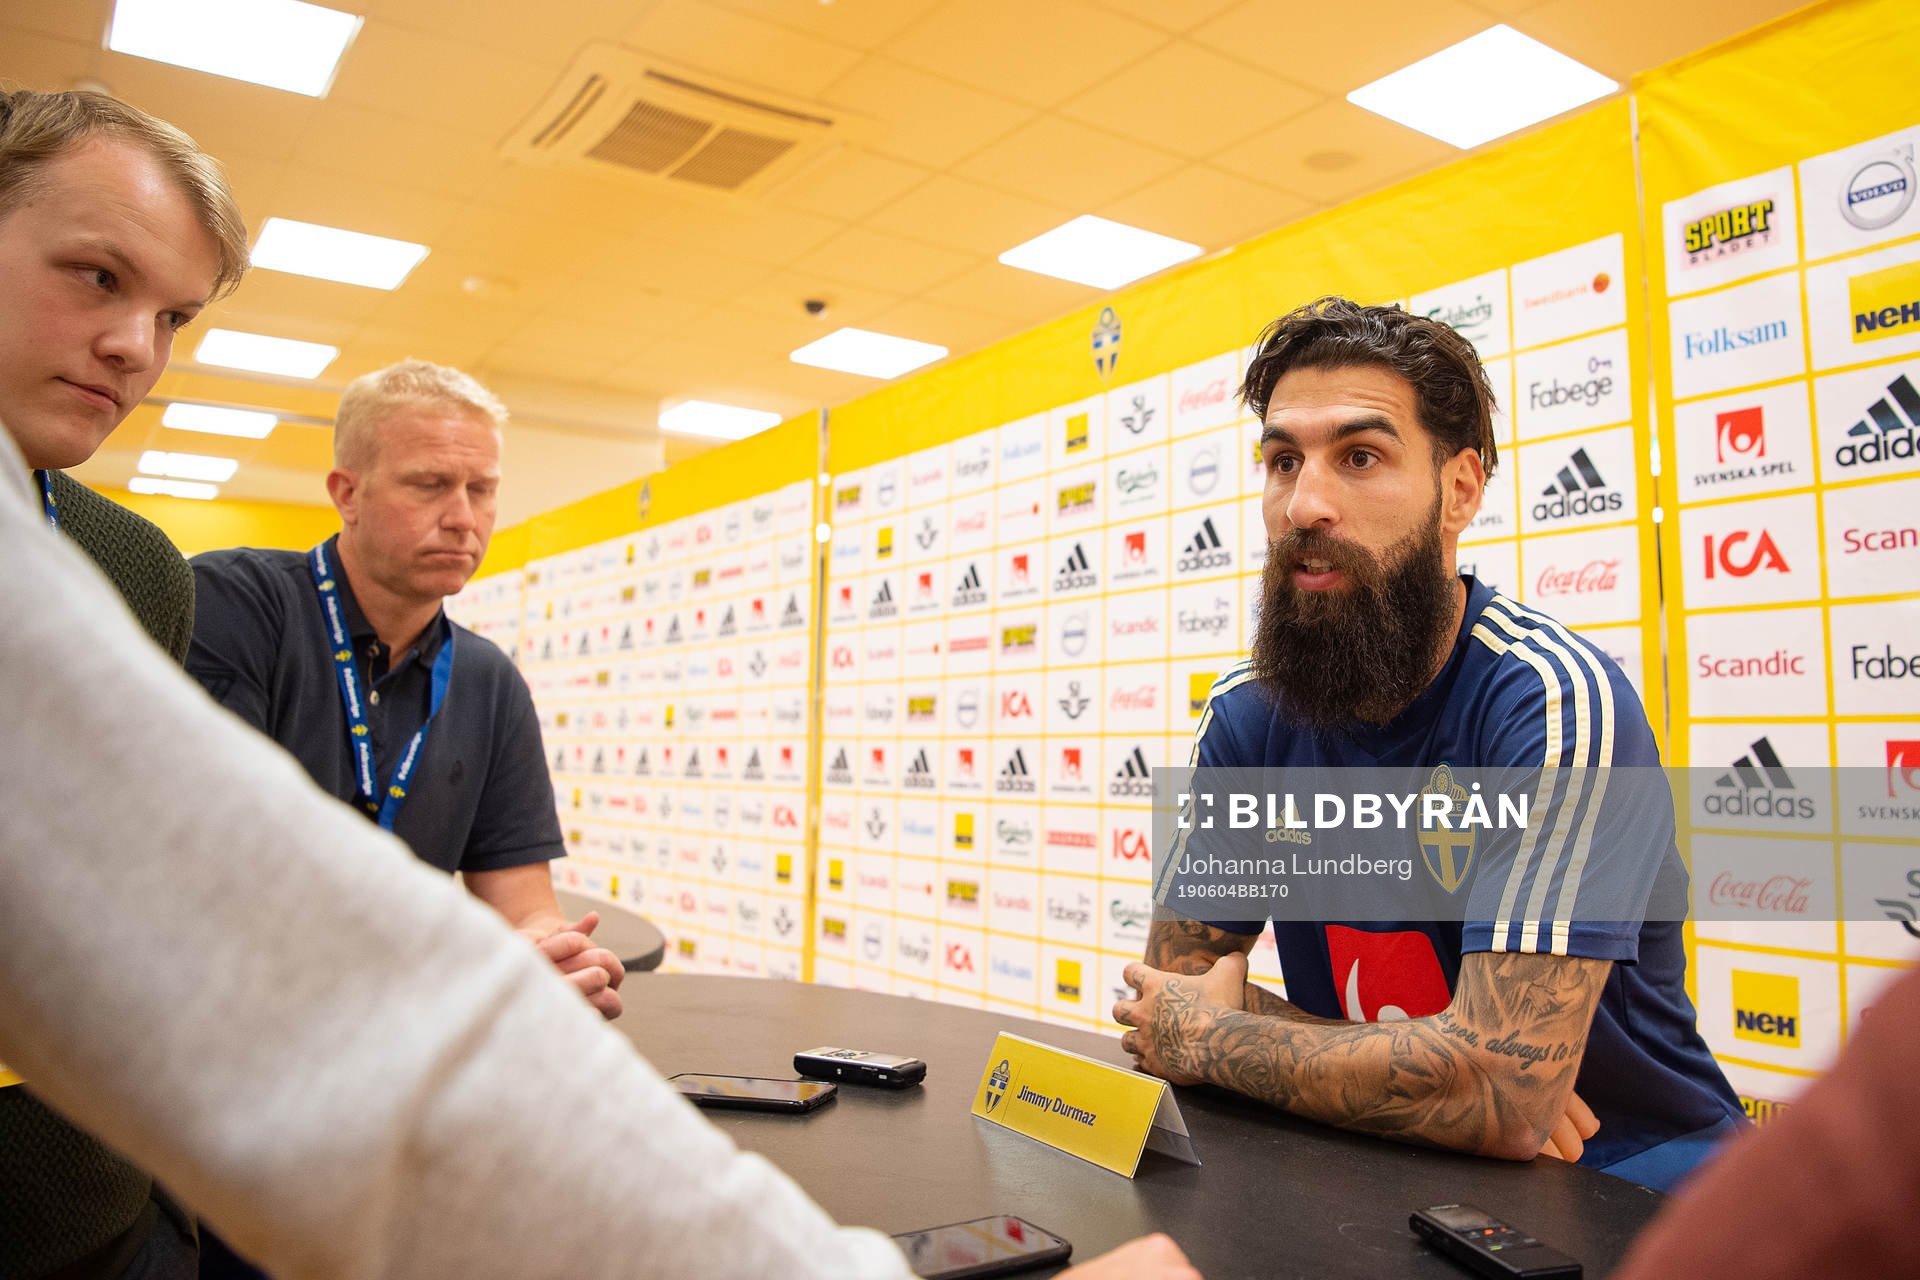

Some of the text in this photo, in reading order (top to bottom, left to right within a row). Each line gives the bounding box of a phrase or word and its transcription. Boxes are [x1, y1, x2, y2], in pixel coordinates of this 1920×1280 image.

[1685, 198, 1774, 254] SPORT
[1690, 235, 1771, 265] BLADET
[1685, 319, 1788, 360] Folksam
[1530, 376, 1613, 410] Fabege
[1694, 461, 1797, 488] SVENSKA SPEL
[1532, 491, 1623, 521] adidas
[1703, 529, 1791, 581] ICA
[1843, 527, 1918, 554] Scan
[1698, 650, 1806, 678] Scandic
[1852, 644, 1920, 680] Fabe
[1703, 788, 1816, 820] adidas
[1112, 828, 1151, 862] ICA
[1485, 1029, 1552, 1071] always
[1016, 1084, 1097, 1127] Jimmy Durmaz
